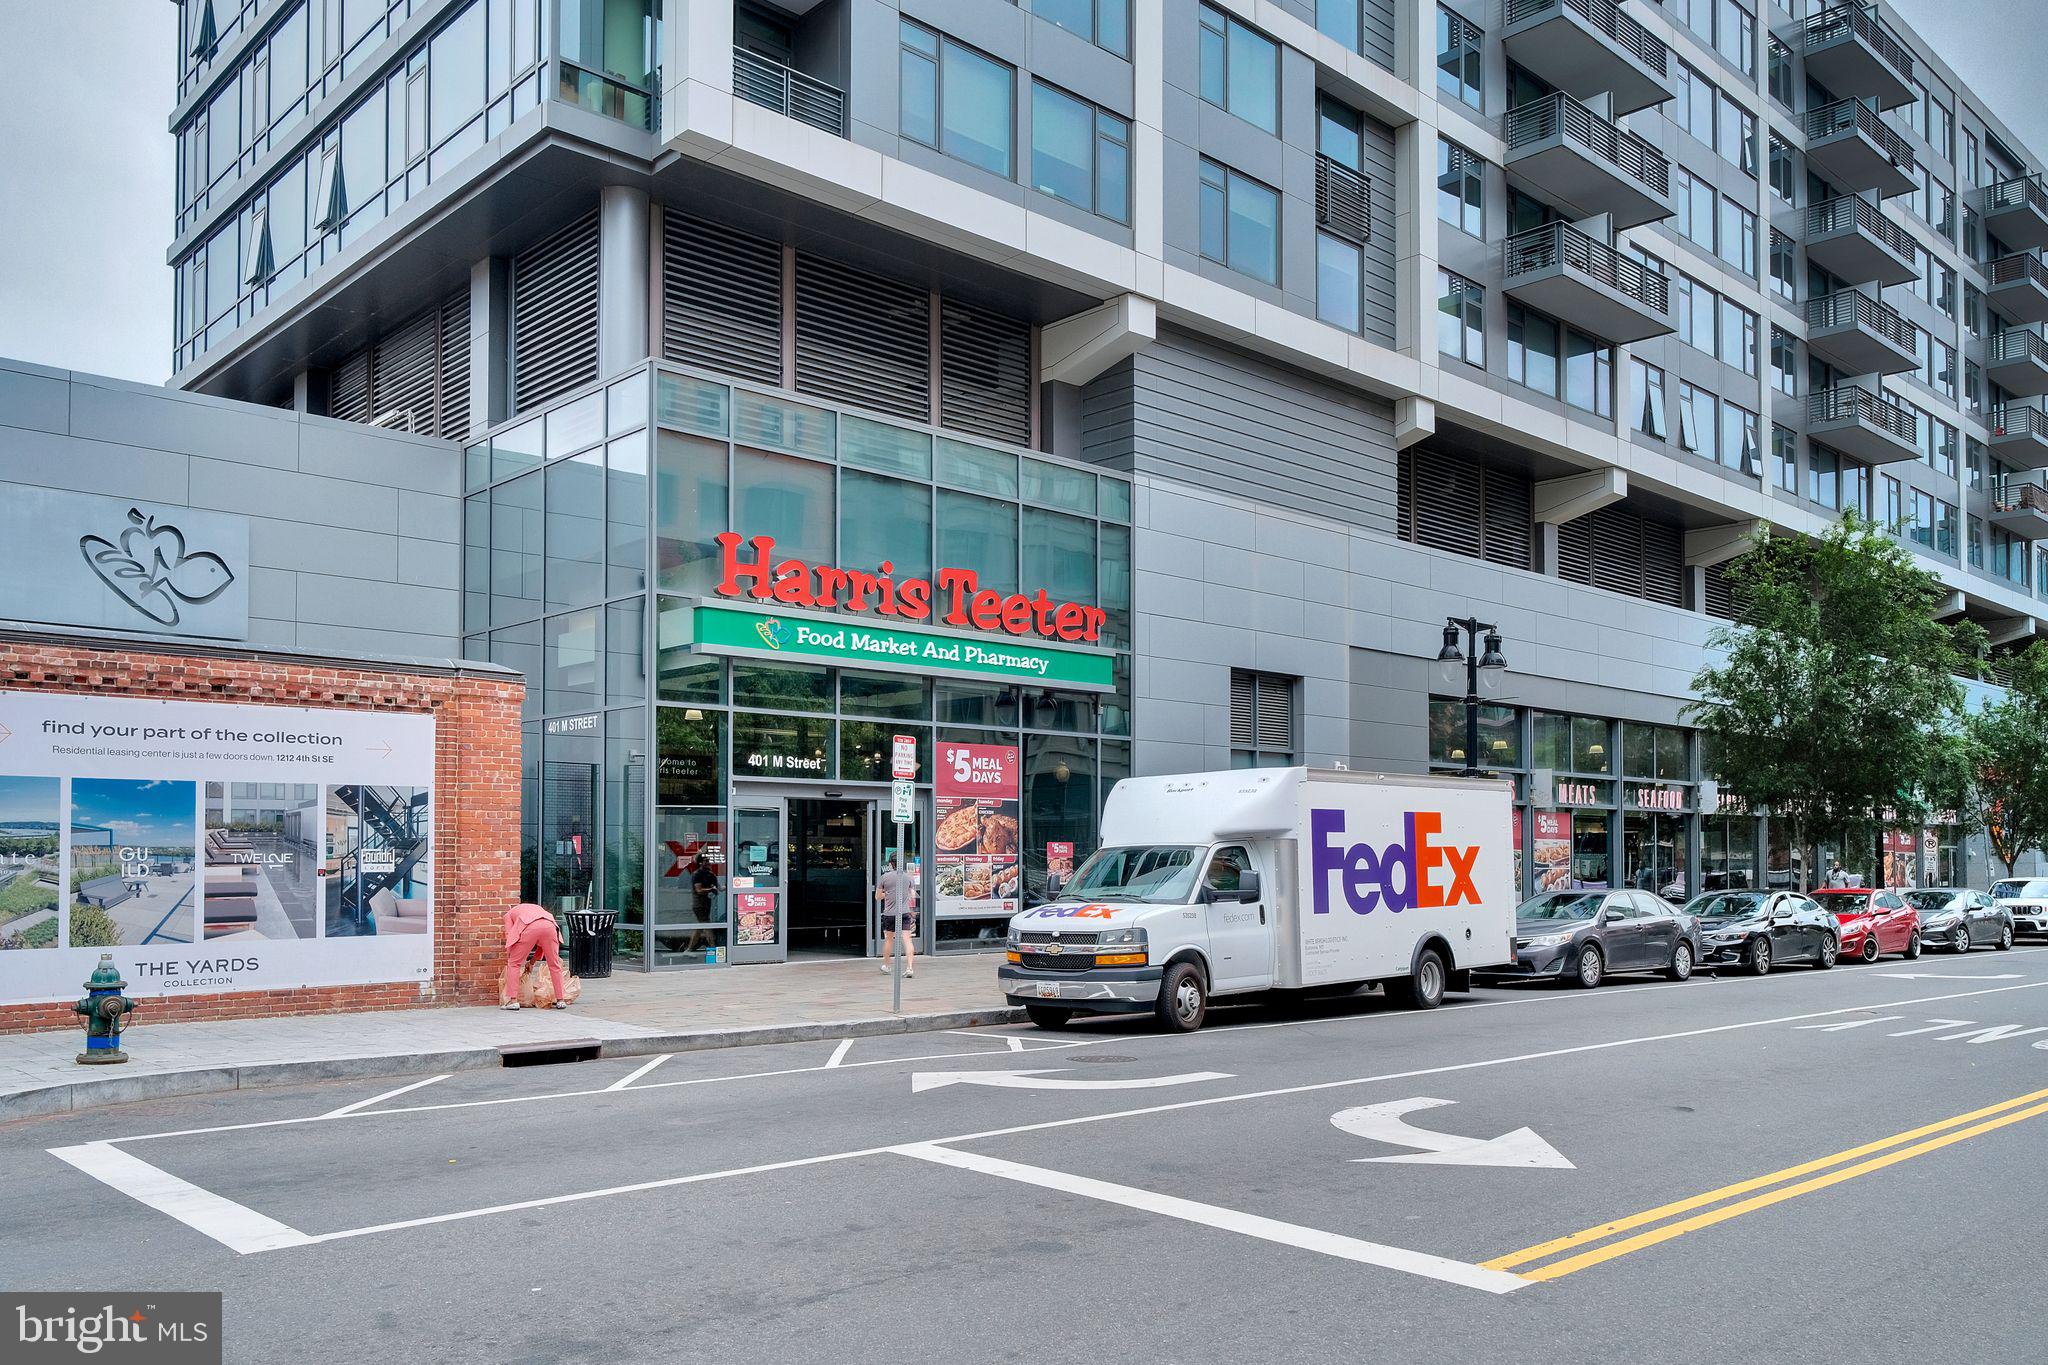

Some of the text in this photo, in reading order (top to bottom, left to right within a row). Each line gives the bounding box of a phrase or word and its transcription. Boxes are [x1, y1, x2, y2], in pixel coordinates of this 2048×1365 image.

[713, 532, 1106, 641] Harris Teeter
[796, 627, 1050, 674] Food Market And Pharmacy
[42, 720, 343, 746] find your part of the collection
[548, 715, 598, 733] 401 M STREET
[52, 745, 107, 756] Residential
[107, 748, 140, 758] leasing
[141, 749, 171, 758] center
[172, 750, 180, 758] is
[181, 751, 198, 759] just
[206, 752, 222, 760] few
[223, 752, 248, 760] doors
[250, 753, 275, 761] down.
[276, 754, 294, 762] 1212
[296, 754, 310, 762] 4th
[311, 755, 321, 763] St
[322, 755, 334, 763] SE
[748, 754, 821, 770] 401 M Street
[672, 767, 698, 775] Teeter
[946, 748, 971, 782] $5
[972, 757, 1003, 770] MEAL
[972, 772, 1002, 784] DAYS
[1558, 783, 1596, 805] MEATS
[1637, 788, 1683, 809] SEAFOOD
[119, 847, 148, 861] GU
[1311, 808, 1482, 915] FedEx
[121, 864, 149, 877] ILD
[1024, 904, 1124, 919] FedEx
[1223, 914, 1255, 923] fedex.com
[135, 957, 259, 976] THE YARDS
[164, 977, 233, 988] COLLECTION
